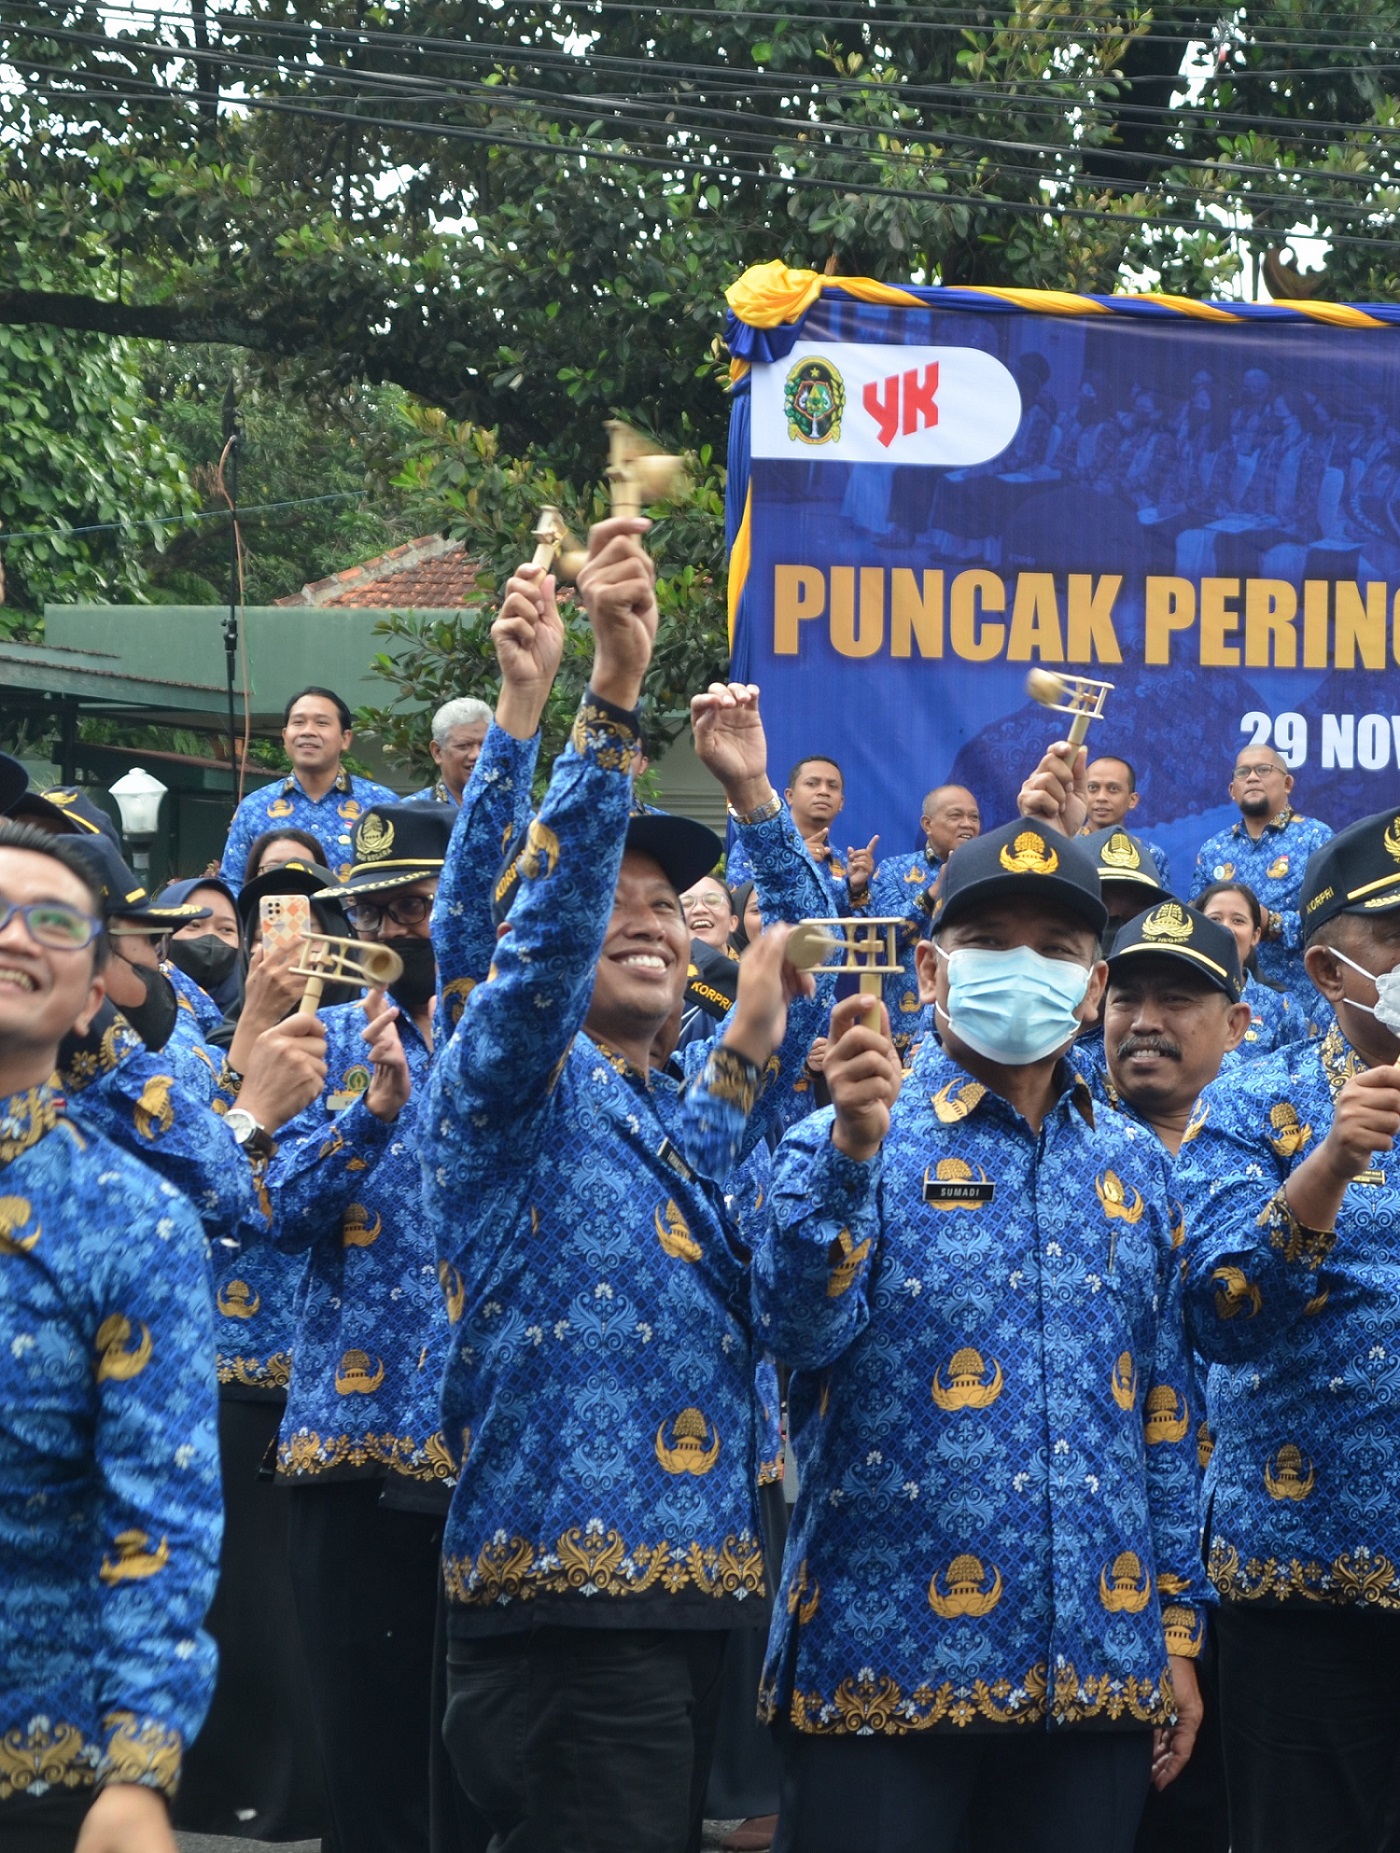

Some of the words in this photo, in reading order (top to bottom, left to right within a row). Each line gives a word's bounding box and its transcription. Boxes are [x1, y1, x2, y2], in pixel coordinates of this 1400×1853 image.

[863, 360, 939, 448] YK
[774, 564, 1123, 664] PUNCAK
[1240, 711, 1307, 770] 29
[1306, 886, 1335, 915] KORPRI
[690, 981, 733, 1011] KORPRI
[940, 1187, 980, 1197] SUMADI
